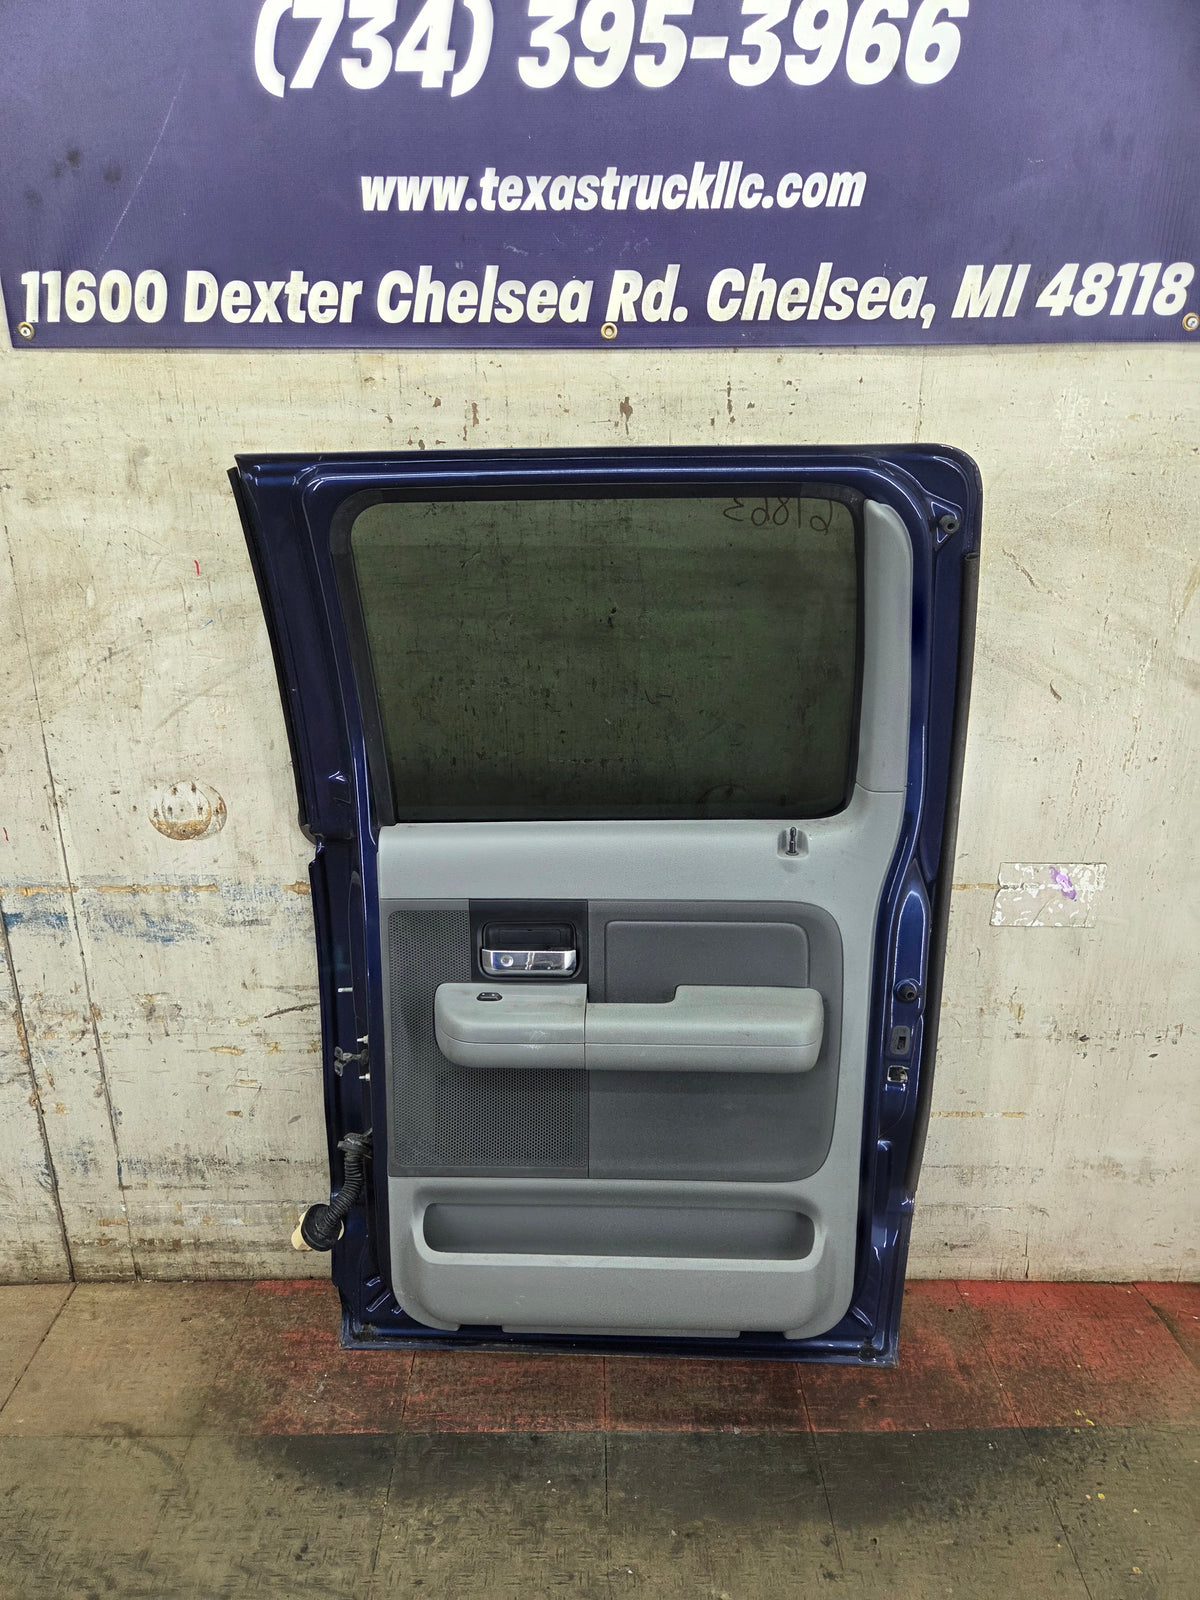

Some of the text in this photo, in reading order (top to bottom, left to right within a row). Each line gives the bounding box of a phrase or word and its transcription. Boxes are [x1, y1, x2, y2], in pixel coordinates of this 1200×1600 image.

[253, 0, 971, 98] (734) 395-3966
[360, 160, 867, 212] www.texastruckllc.com
[20, 261, 1195, 329] 11600 Dexter Chelsea Rd. Chelsea, MI 48118
